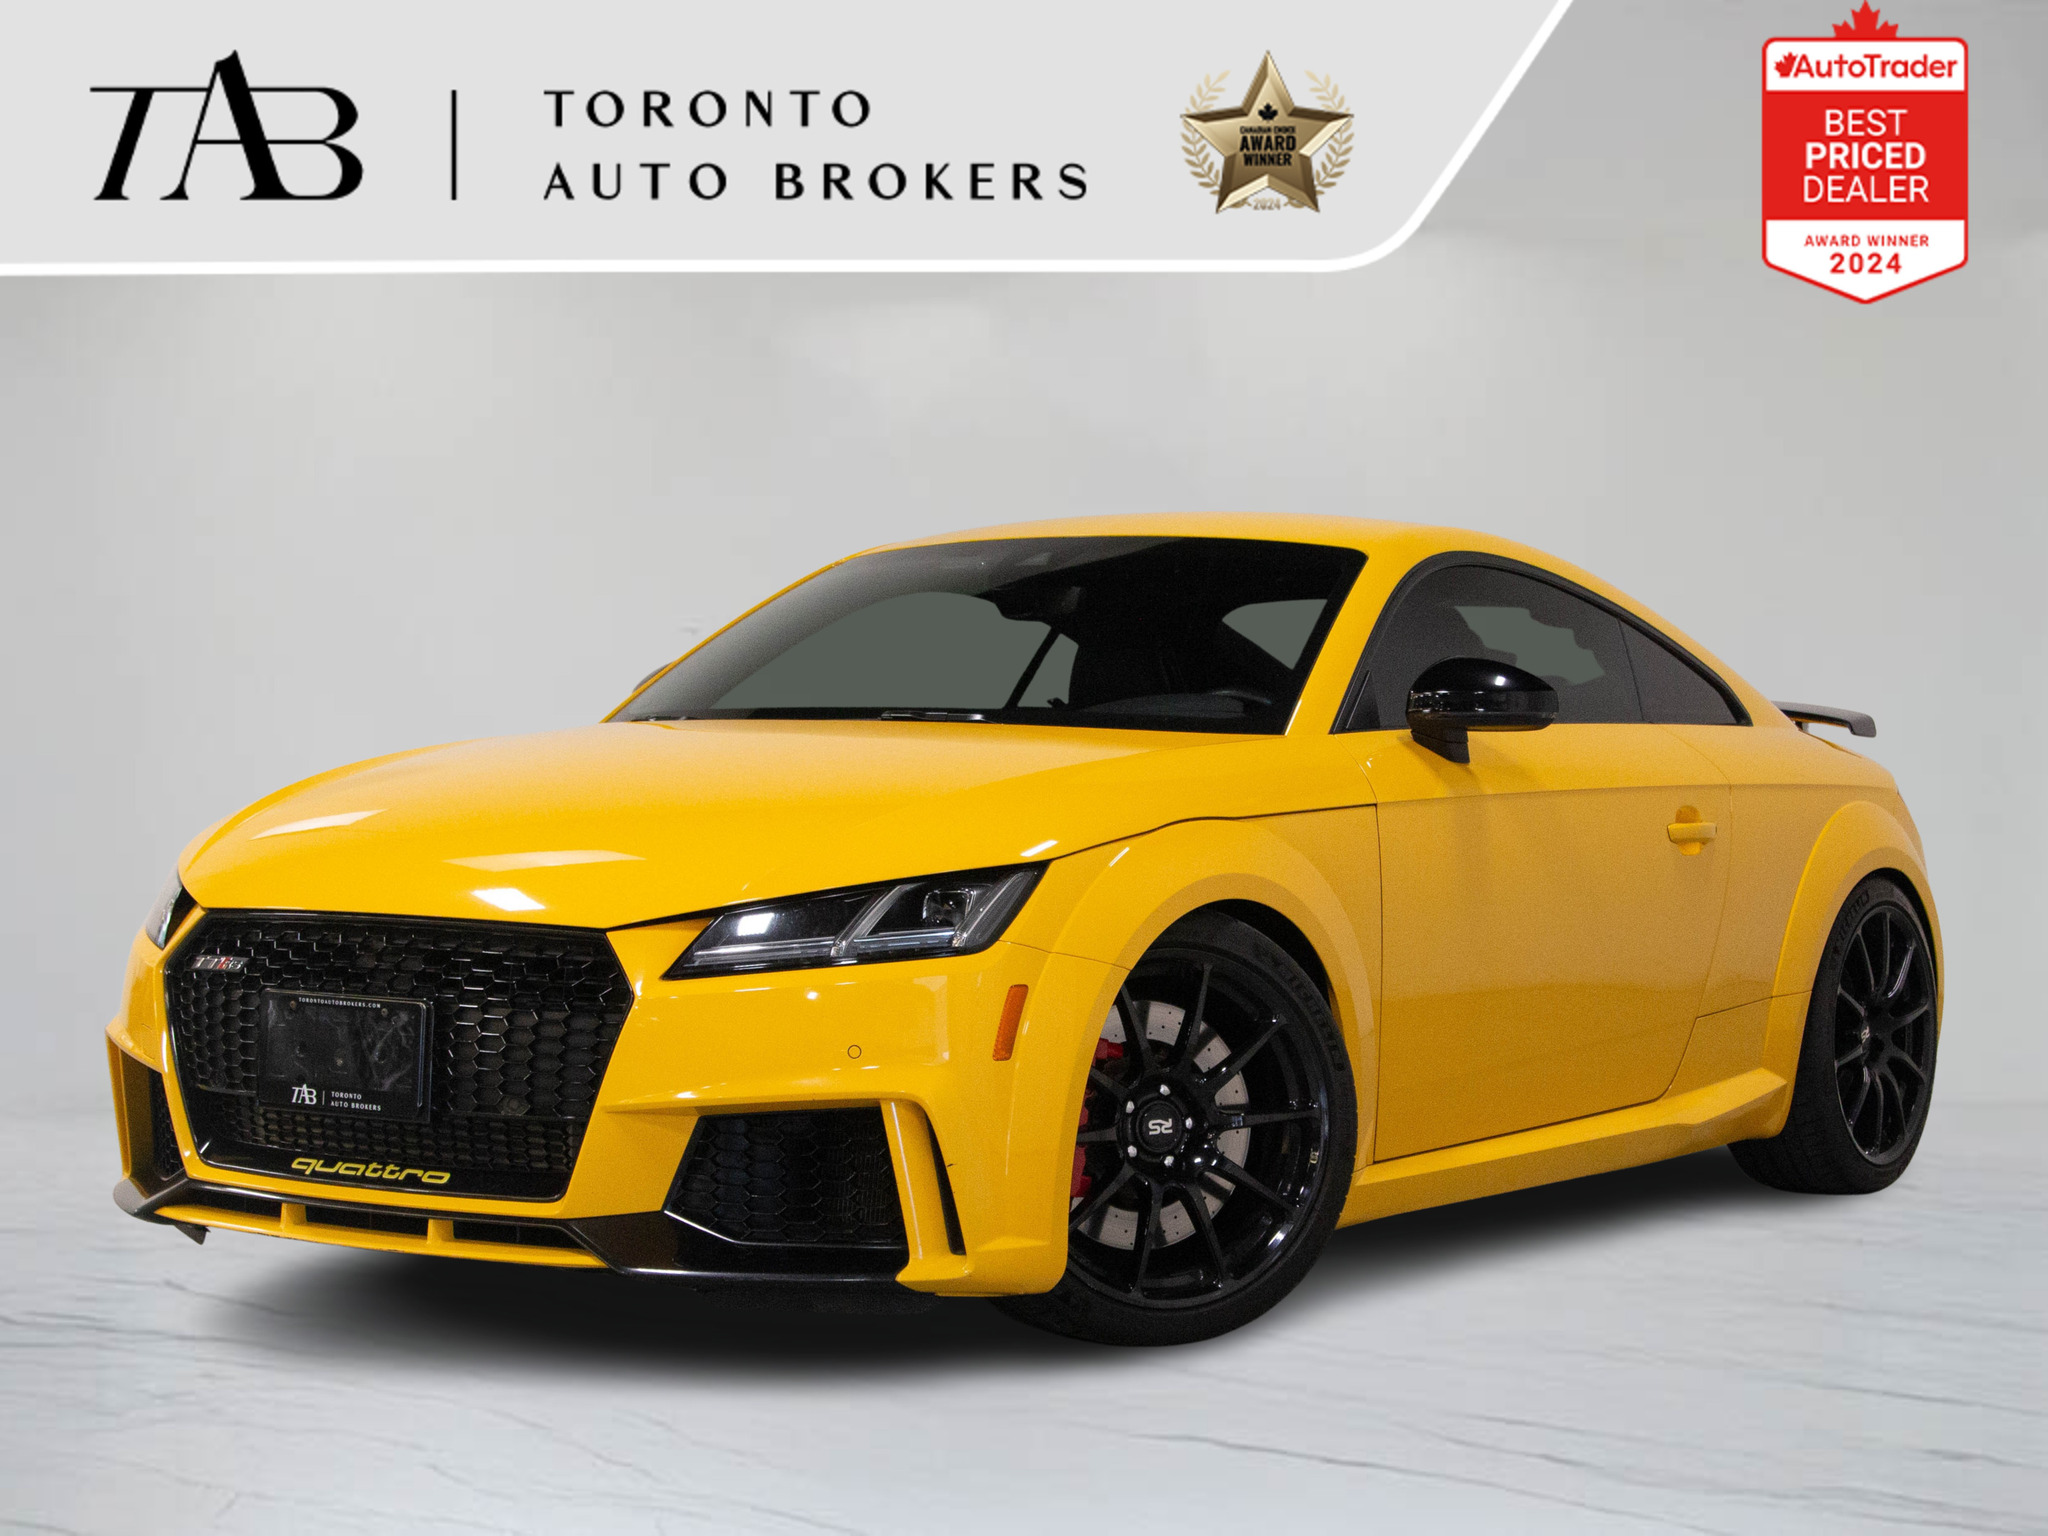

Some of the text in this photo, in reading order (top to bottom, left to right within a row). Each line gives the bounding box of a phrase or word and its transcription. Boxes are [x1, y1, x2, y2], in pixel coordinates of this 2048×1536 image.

[291, 1083, 317, 1105] TAB
[331, 1091, 362, 1100] TORONTO
[330, 1100, 382, 1111] AUTO BROKERS
[291, 1157, 451, 1184] quattro
